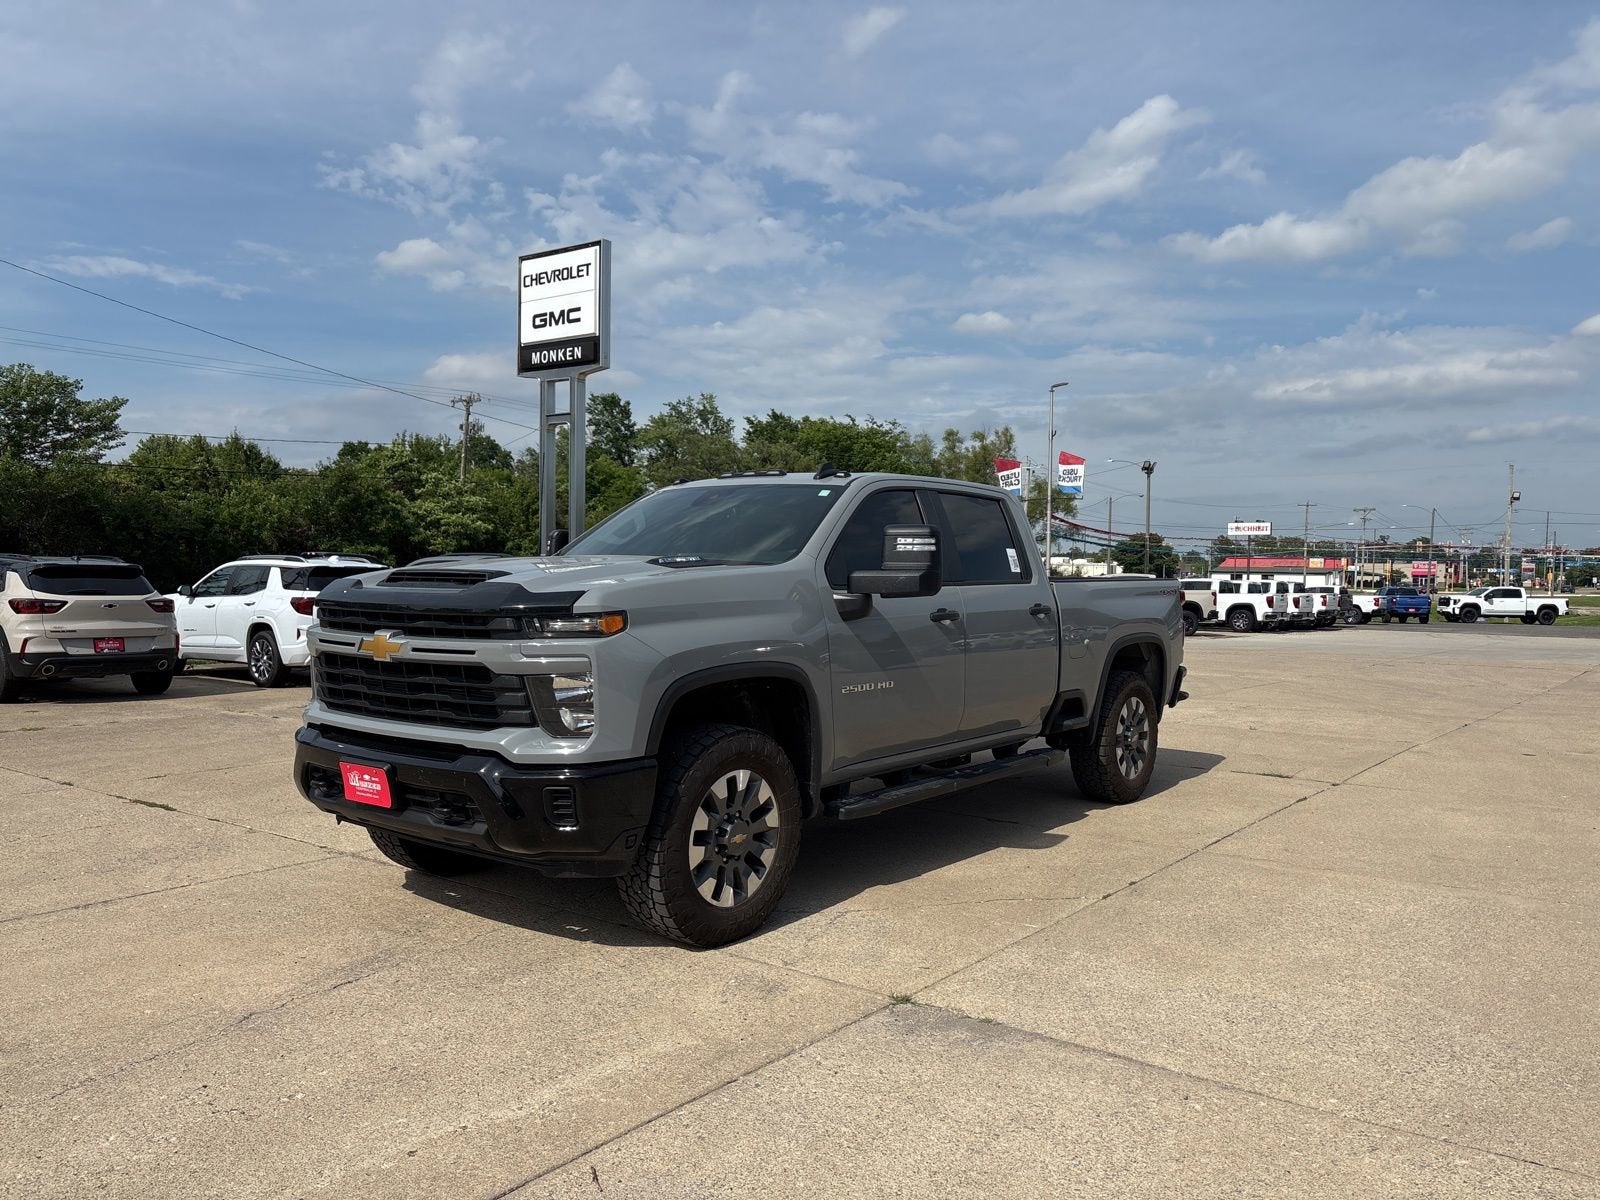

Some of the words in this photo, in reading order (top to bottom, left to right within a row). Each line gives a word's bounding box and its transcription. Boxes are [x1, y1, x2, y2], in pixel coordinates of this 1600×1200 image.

[523, 262, 592, 288] CHEVROLET
[532, 306, 582, 329] GMC
[531, 346, 582, 365] MONKEN
[841, 683, 875, 694] 2500
[877, 680, 894, 689] HD
